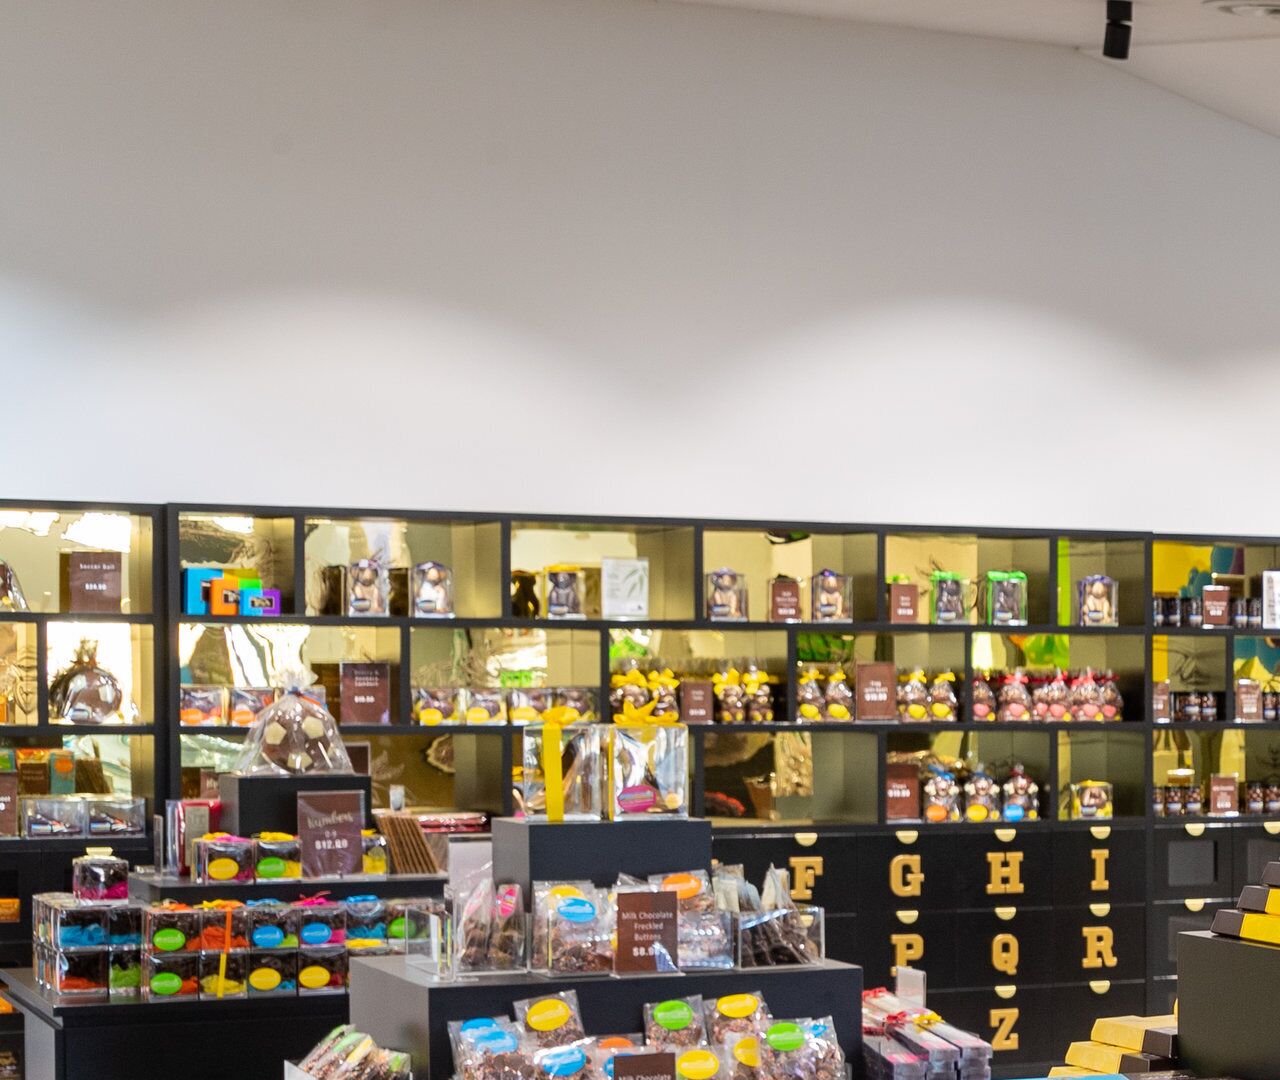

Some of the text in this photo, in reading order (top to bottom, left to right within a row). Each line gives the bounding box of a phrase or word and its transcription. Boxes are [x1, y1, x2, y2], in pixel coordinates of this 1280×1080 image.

[789, 856, 823, 900] F
[889, 854, 925, 897] G
[986, 851, 1024, 894] H
[1090, 849, 1109, 890] I
[634, 922, 664, 930] Freckled
[639, 911, 674, 920] Chocolate
[890, 934, 924, 976] P
[991, 933, 1019, 975] Q
[1081, 926, 1117, 968] R
[990, 1007, 1019, 1050] Z
